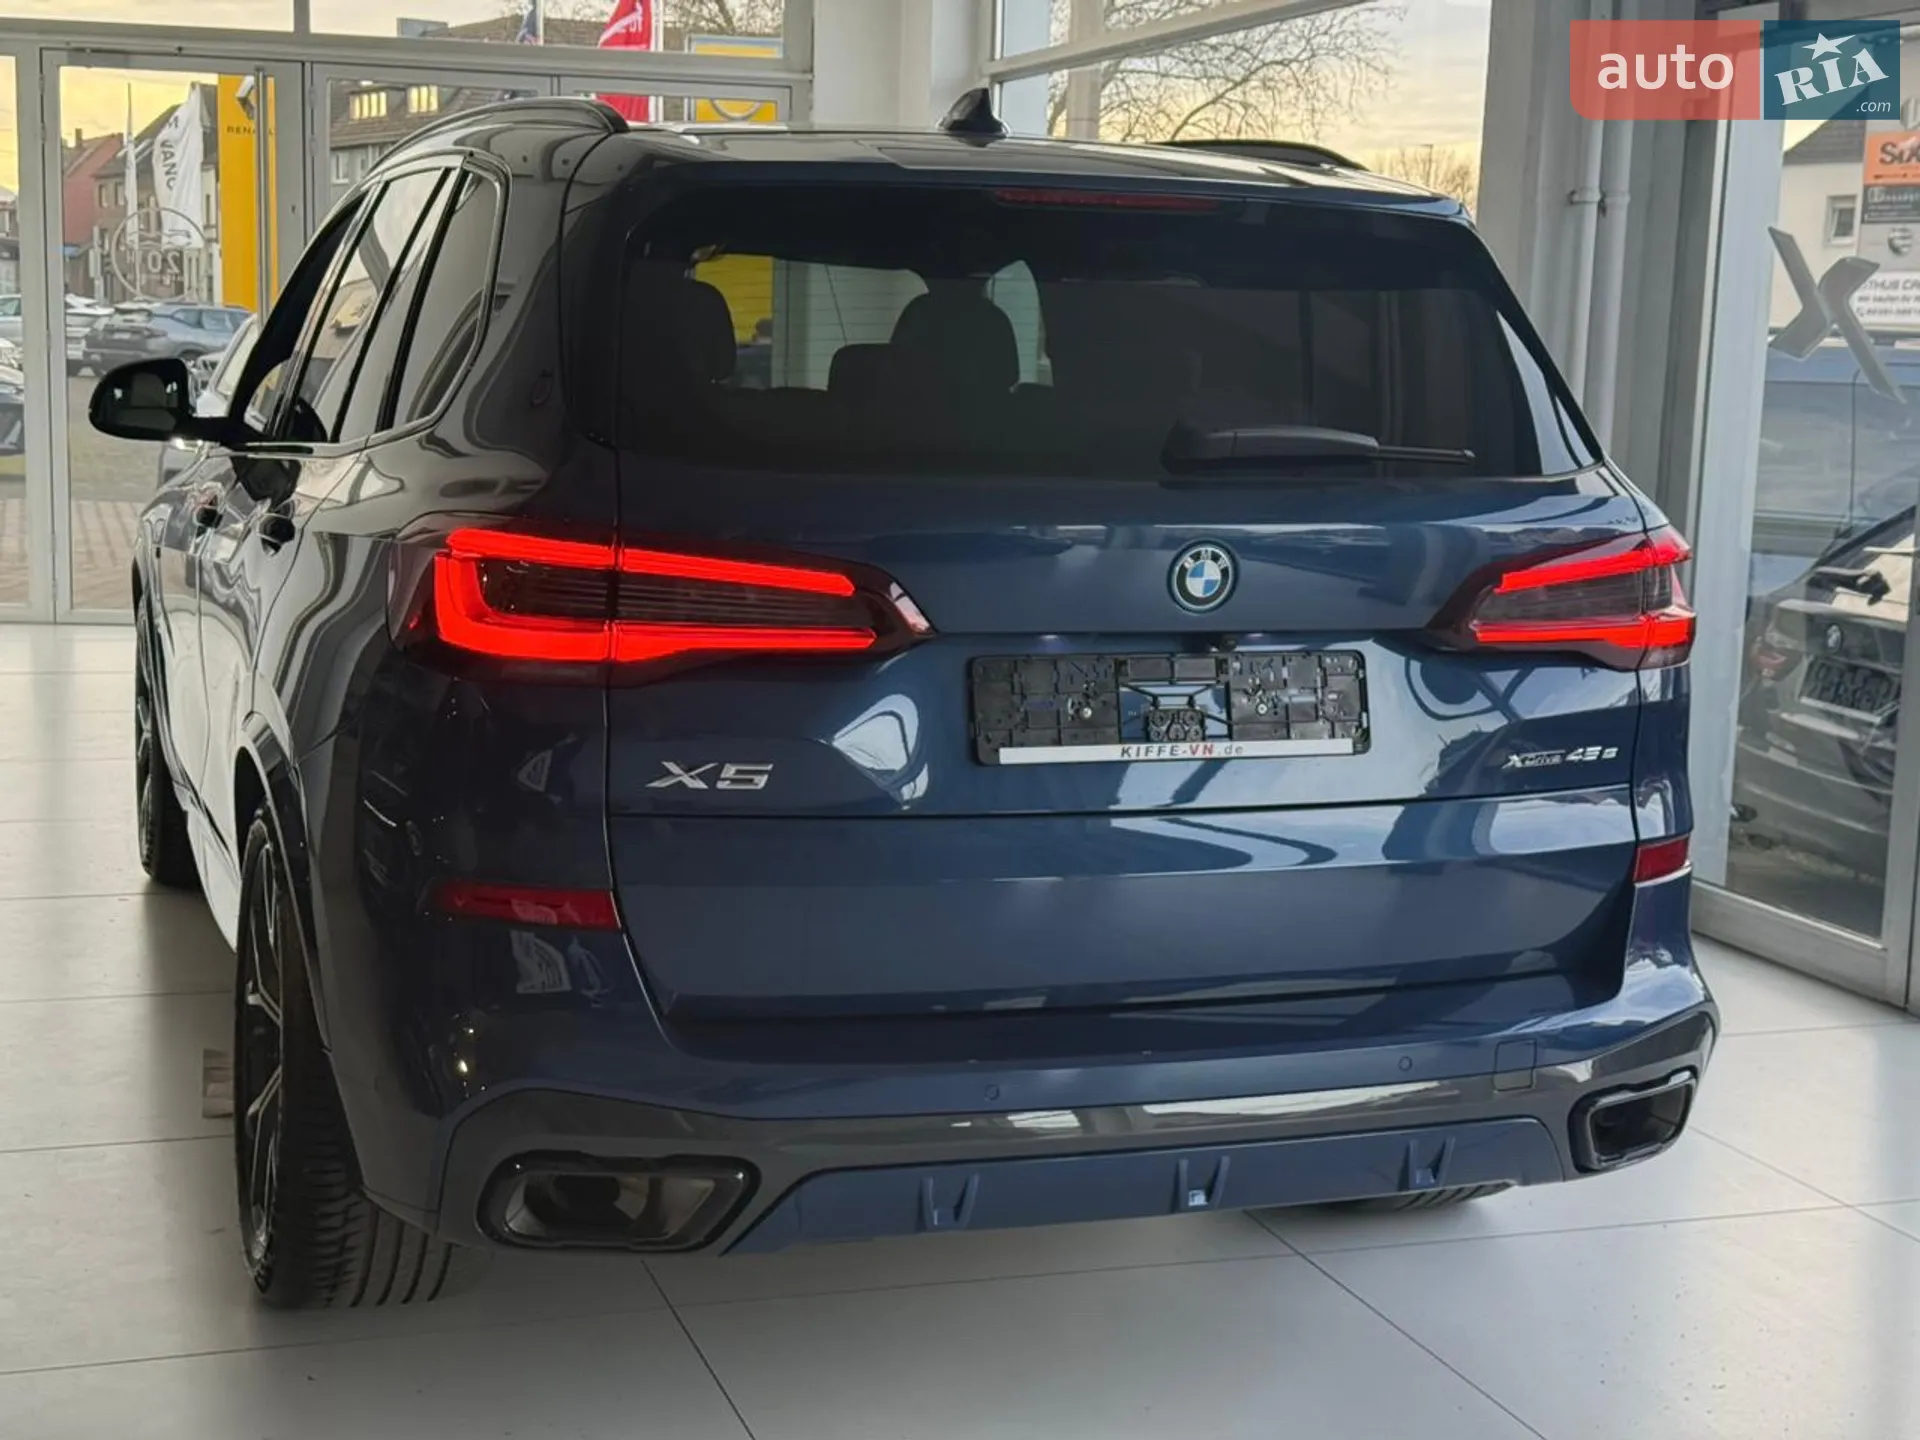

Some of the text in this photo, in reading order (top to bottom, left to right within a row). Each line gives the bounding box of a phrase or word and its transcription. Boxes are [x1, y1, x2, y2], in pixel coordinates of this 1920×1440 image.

[1176, 548, 1228, 571] BMW
[1119, 743, 1244, 759] KIFFE-VN.de
[645, 760, 774, 790] X5
